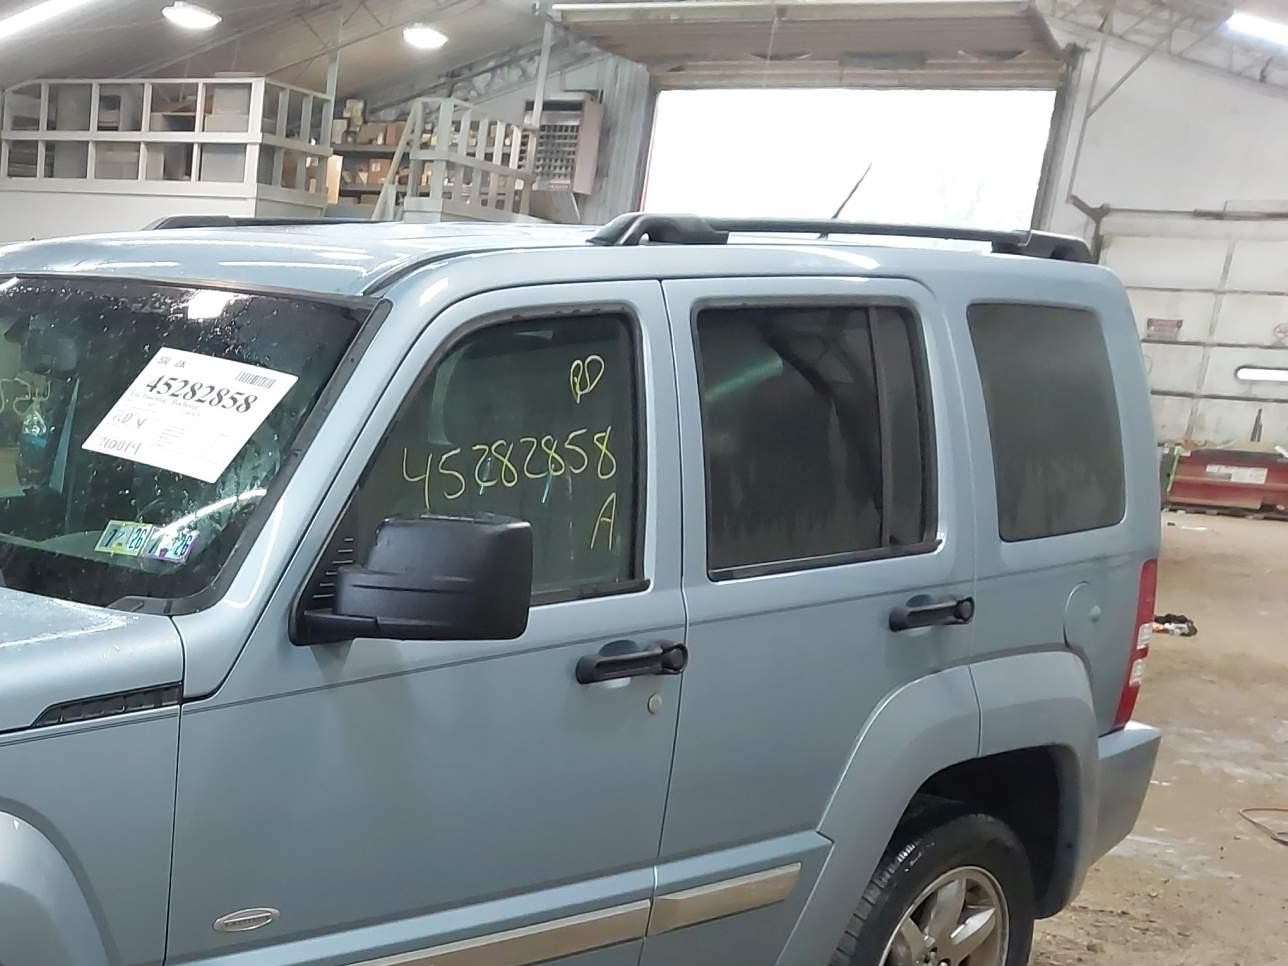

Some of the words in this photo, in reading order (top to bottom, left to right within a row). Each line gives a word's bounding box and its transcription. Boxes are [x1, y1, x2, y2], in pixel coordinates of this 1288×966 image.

[145, 374, 258, 414] 45282858
[401, 425, 618, 512] 45282858
[590, 491, 618, 551] A
